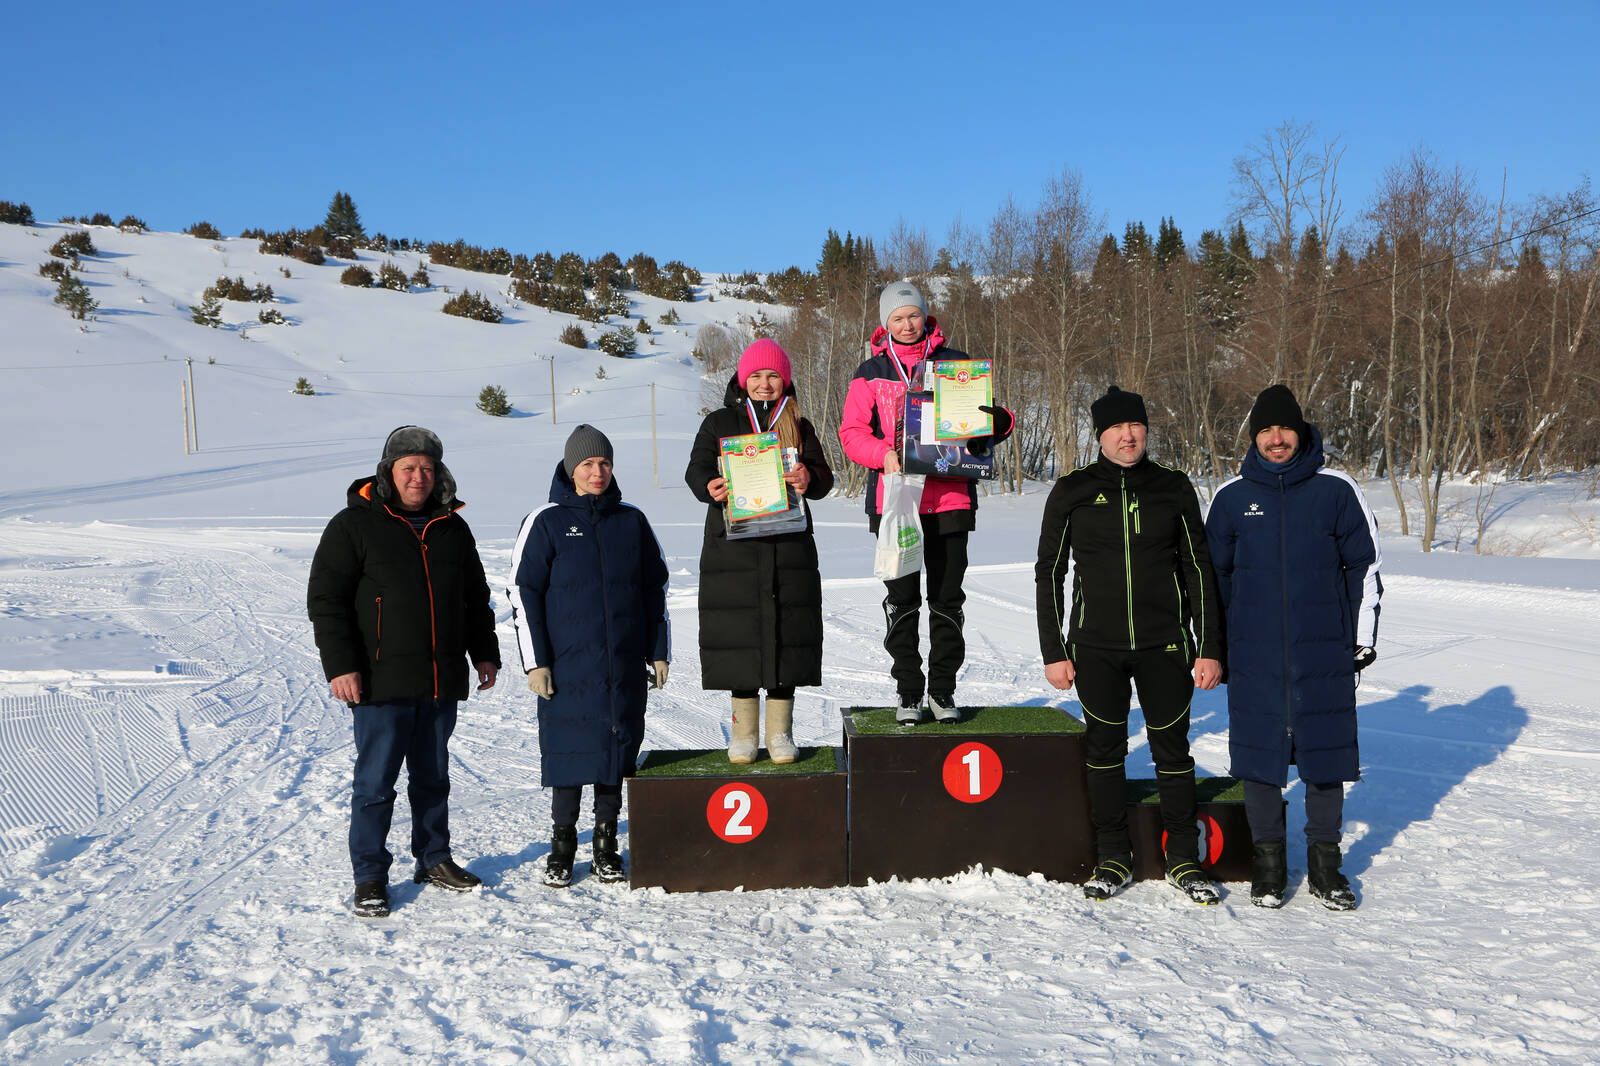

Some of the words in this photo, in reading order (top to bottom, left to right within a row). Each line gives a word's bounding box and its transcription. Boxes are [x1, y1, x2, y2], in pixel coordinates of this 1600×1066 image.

[980, 469, 986, 477] 6
[962, 750, 981, 796] 1
[723, 790, 753, 836] 2
